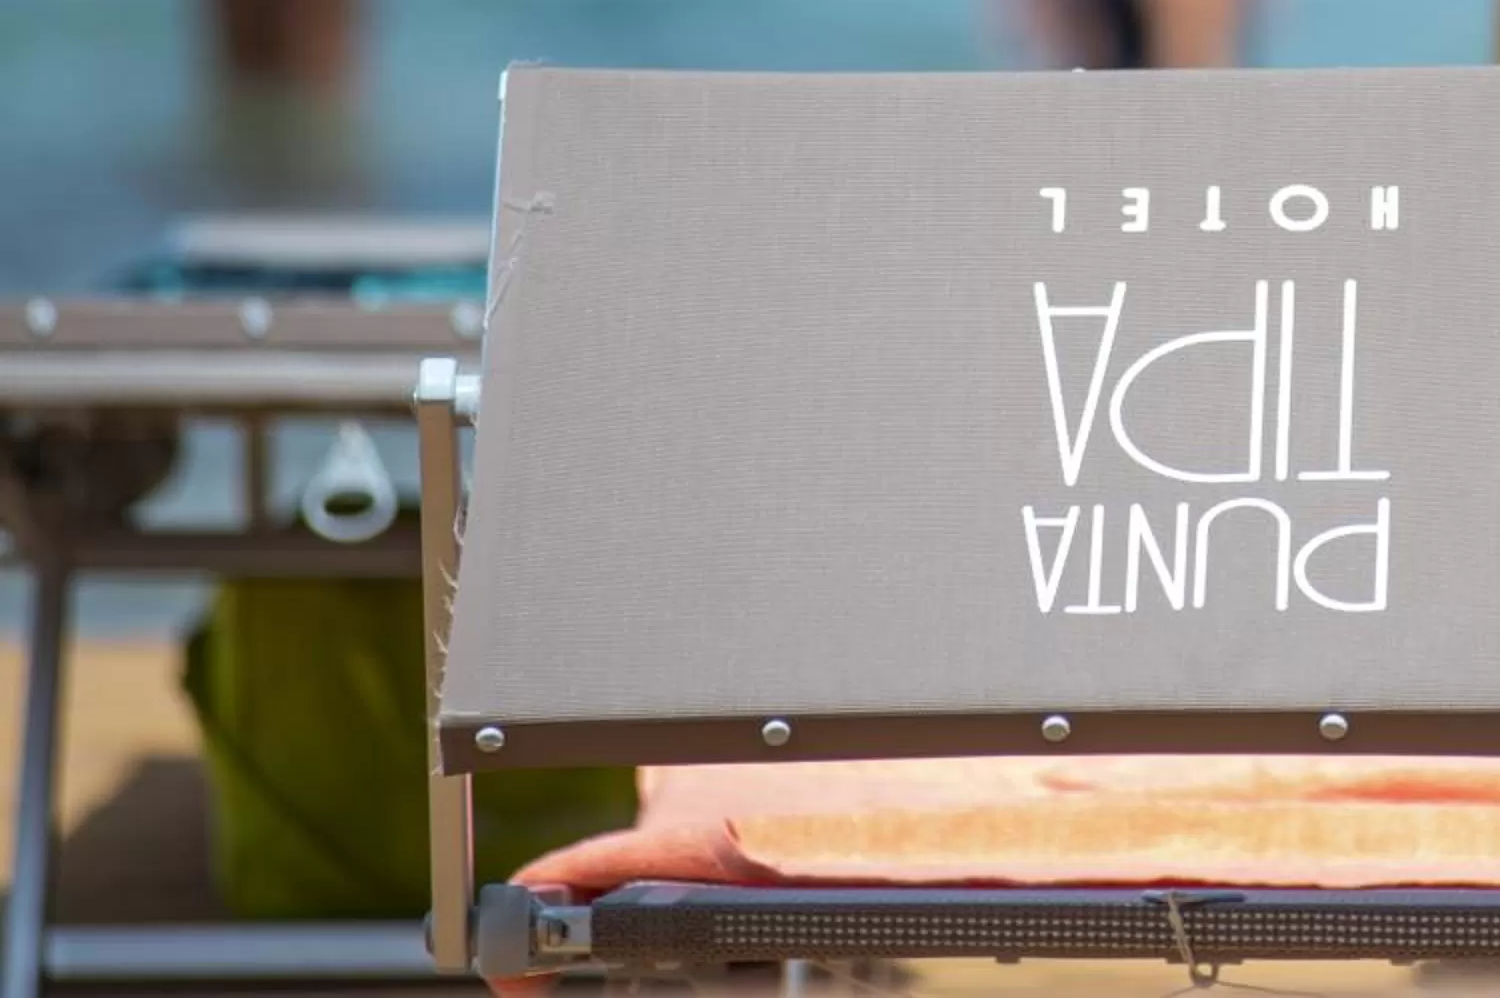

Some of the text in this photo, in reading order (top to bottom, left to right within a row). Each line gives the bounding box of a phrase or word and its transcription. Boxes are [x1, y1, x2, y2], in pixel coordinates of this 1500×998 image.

[1038, 182, 1402, 235] HOTEL
[1032, 277, 1392, 488] TIPA
[1019, 495, 1392, 616] PUNTA
